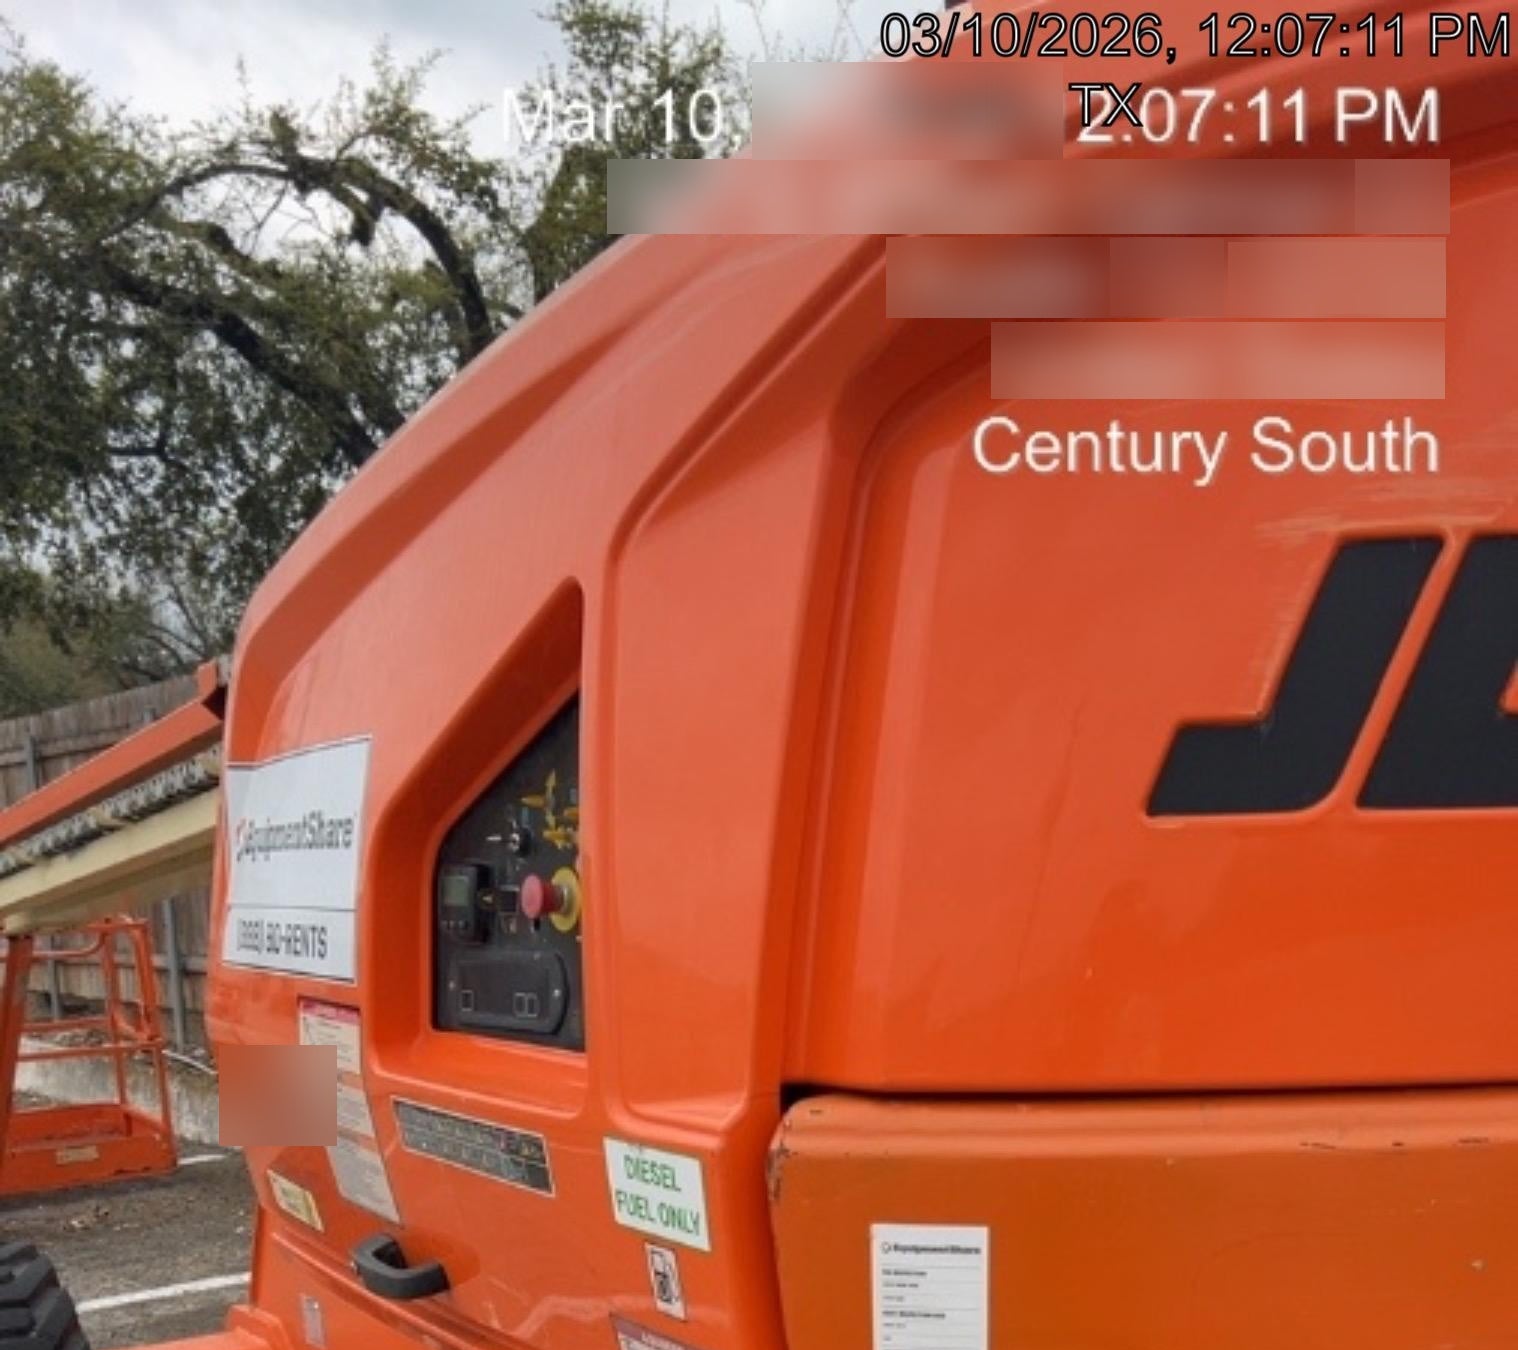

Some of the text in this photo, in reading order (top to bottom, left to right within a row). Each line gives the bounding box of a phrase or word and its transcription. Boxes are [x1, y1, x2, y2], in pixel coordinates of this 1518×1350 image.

[624, 1154, 682, 1193] DIESEL
[615, 1189, 701, 1237] FUEL ONLY
